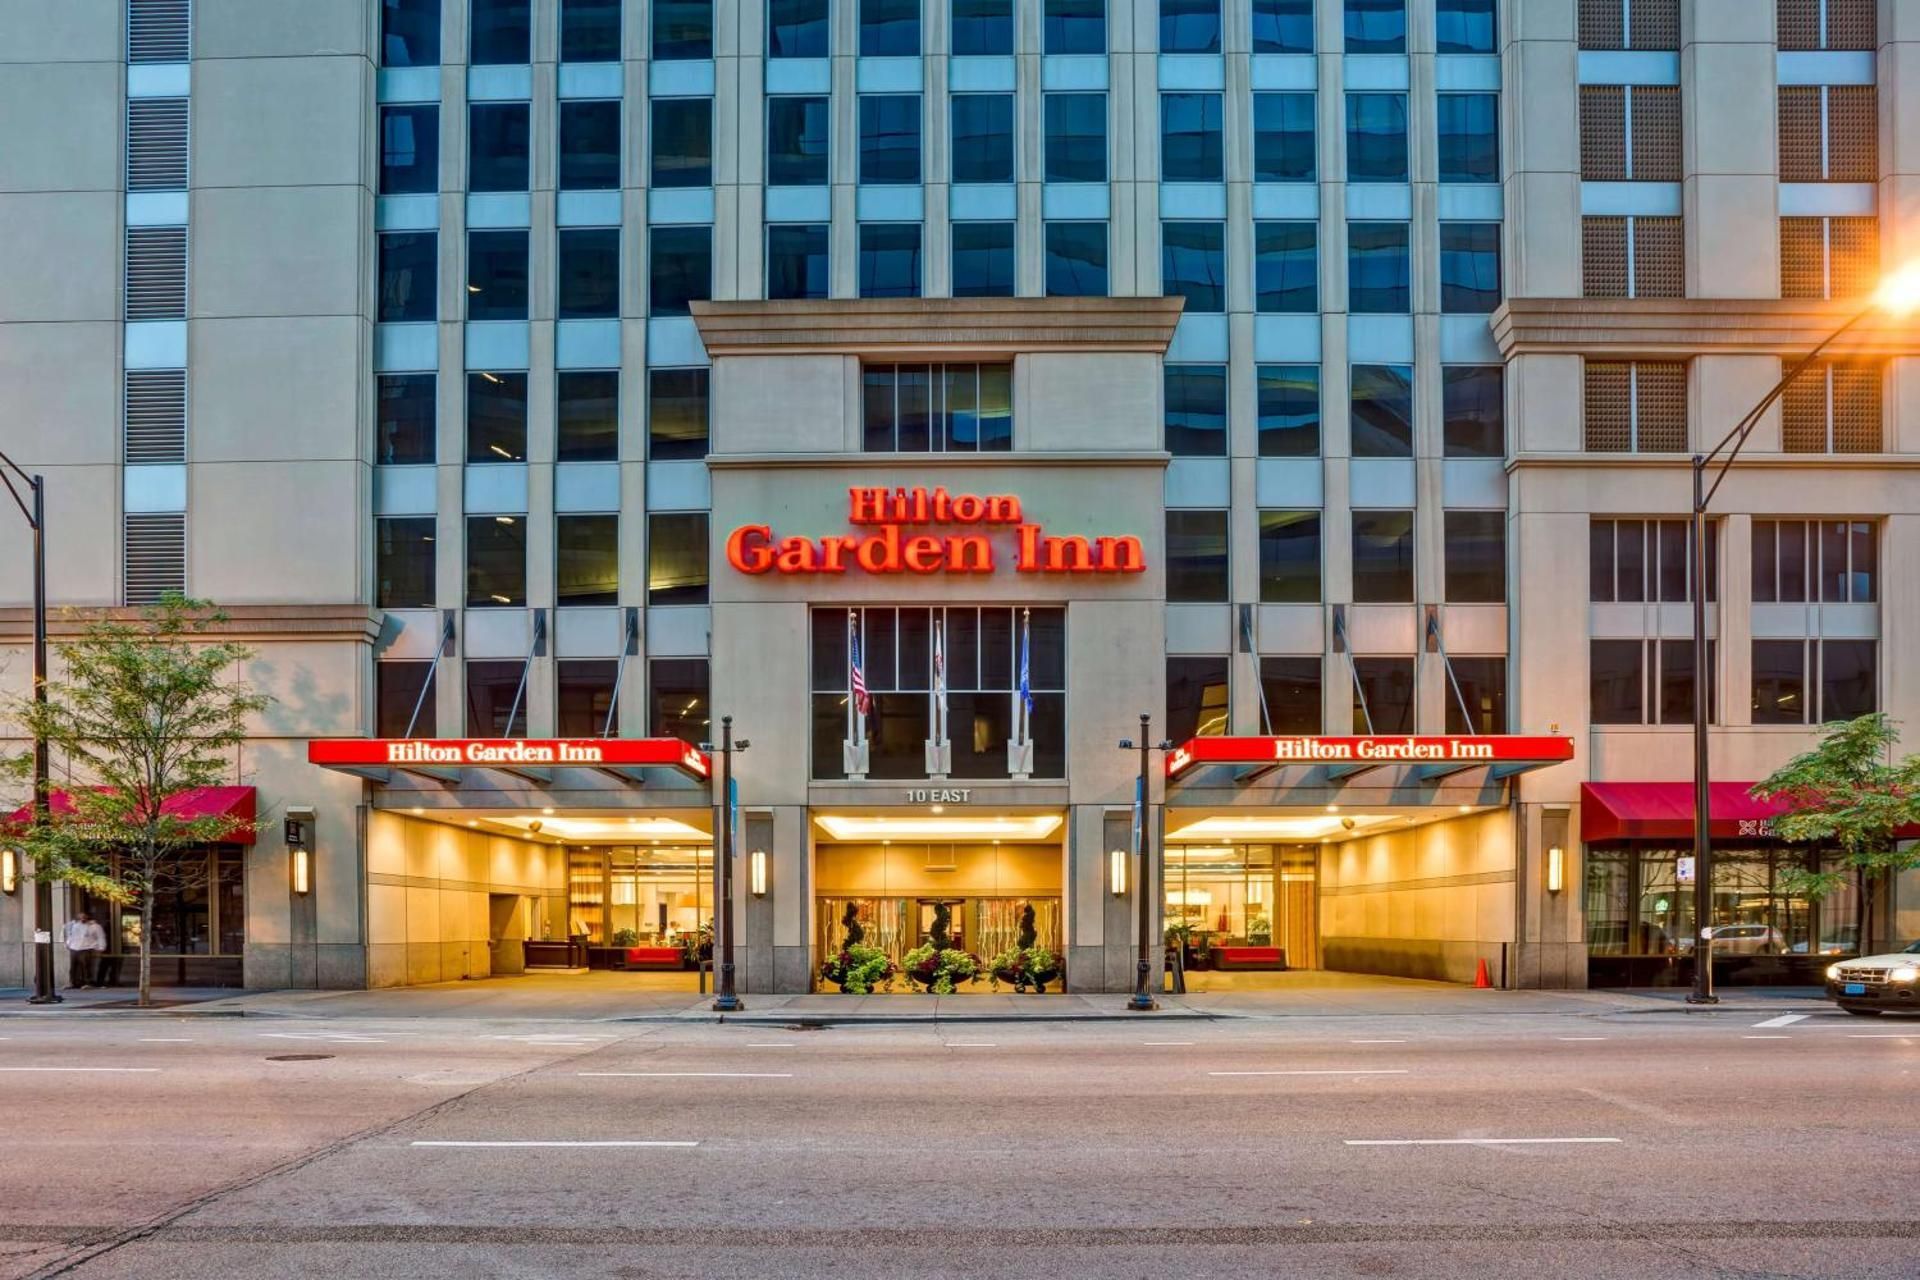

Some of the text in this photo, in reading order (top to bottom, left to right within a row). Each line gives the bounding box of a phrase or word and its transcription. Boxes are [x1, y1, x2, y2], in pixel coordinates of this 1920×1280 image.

[849, 486, 1022, 524] Hilton
[725, 524, 1146, 574] Garden Inn
[387, 741, 602, 761] Hilton Garden Inn
[1275, 740, 1493, 759] Hilton Garden Inn
[907, 789, 970, 802] 10 EAST
